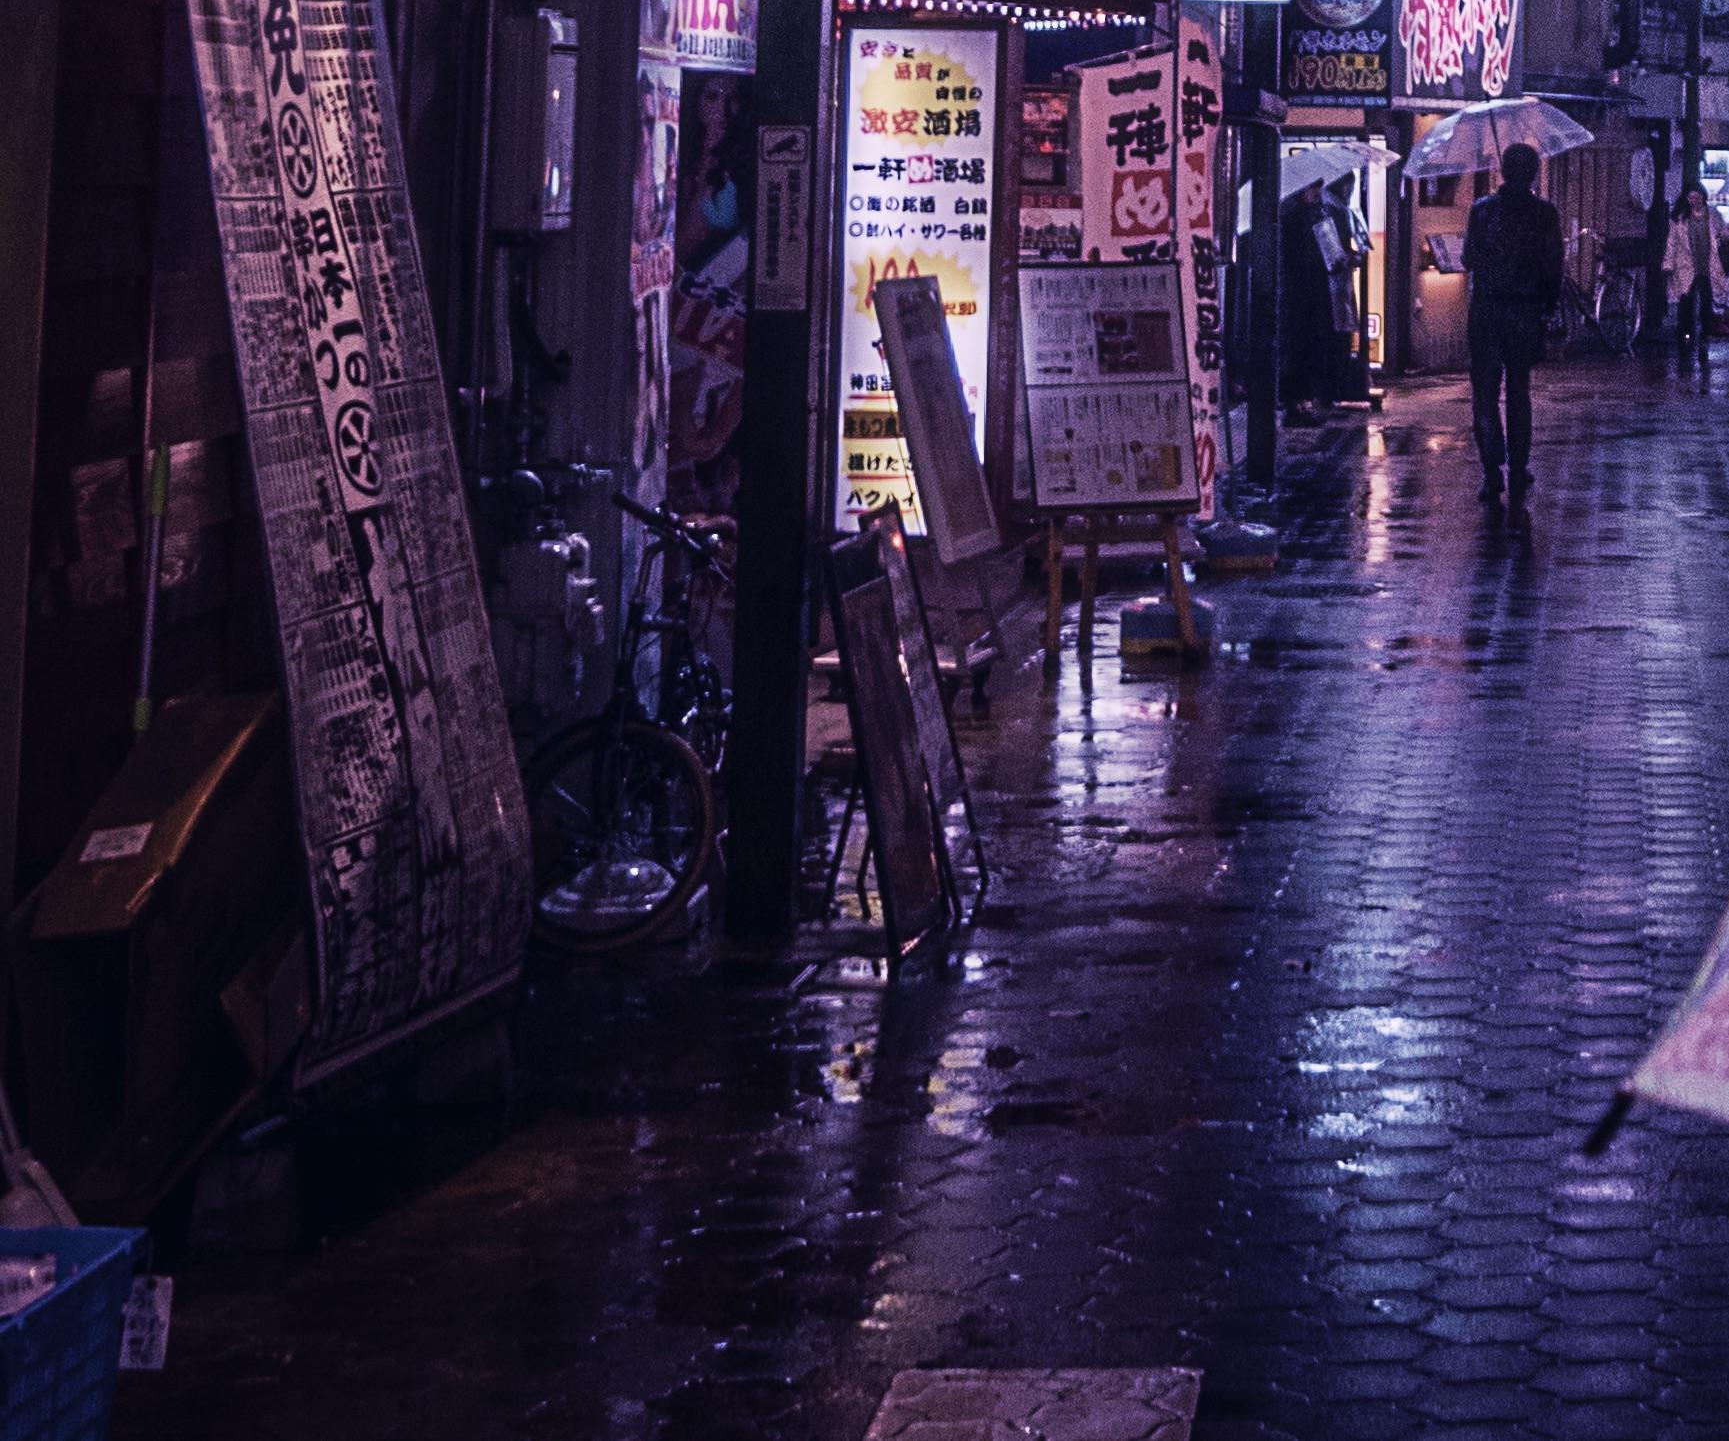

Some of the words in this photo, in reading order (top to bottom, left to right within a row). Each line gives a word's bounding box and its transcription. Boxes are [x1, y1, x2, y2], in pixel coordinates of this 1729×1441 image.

[859, 107, 983, 138] 激安酒場
[851, 153, 987, 185] 一軒め酒場
[310, 208, 371, 388] 日本一の
